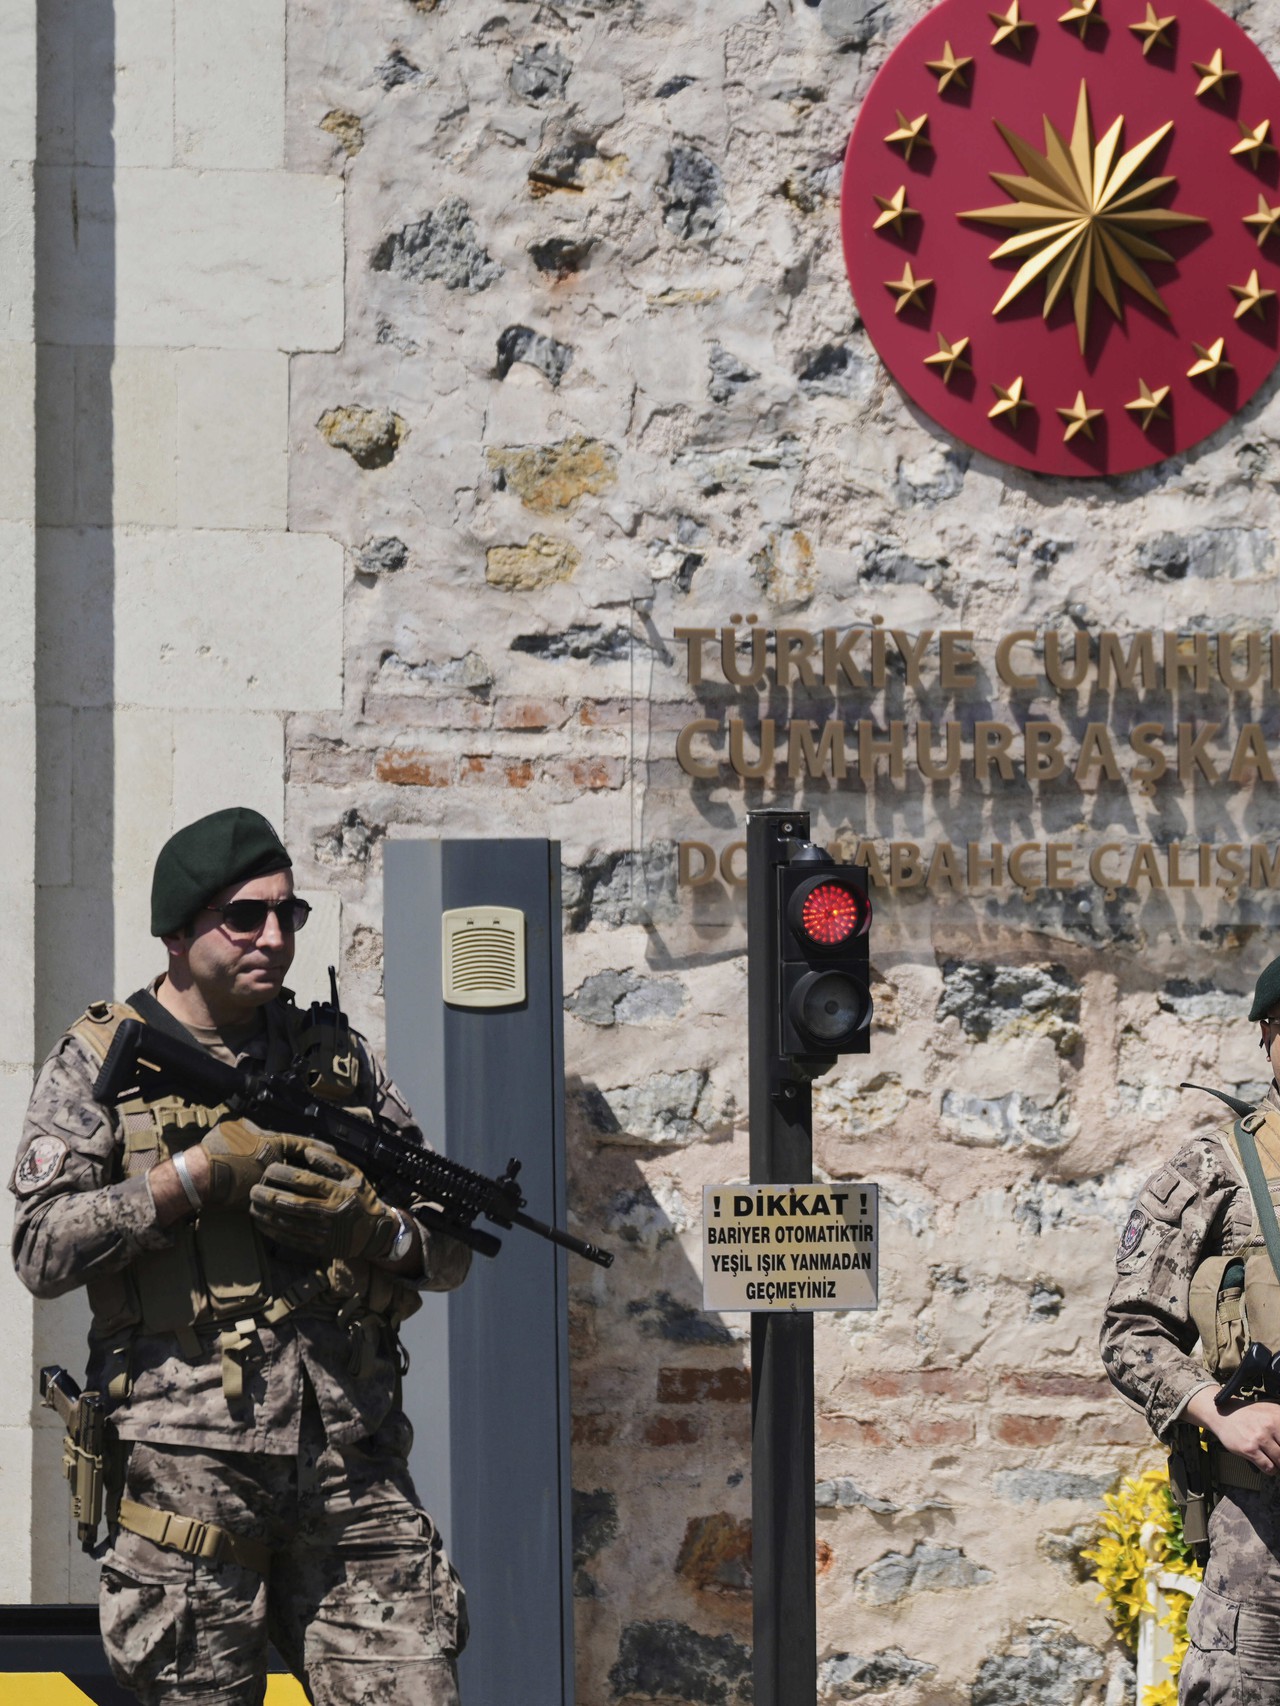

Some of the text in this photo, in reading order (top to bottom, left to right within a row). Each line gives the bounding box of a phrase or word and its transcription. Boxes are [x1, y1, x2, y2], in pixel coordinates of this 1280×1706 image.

[674, 613, 976, 688] TÜRKİYE
[678, 841, 1074, 901] DOABAHÇE
[713, 1189, 868, 1218] ! DİKKAT !
[708, 1219, 874, 1244] BARİYER OTOMATİKTİR
[711, 1250, 872, 1277] YEŞİL IŞIK YANMADAN
[746, 1276, 836, 1304] GEÇMEYİNİZ
